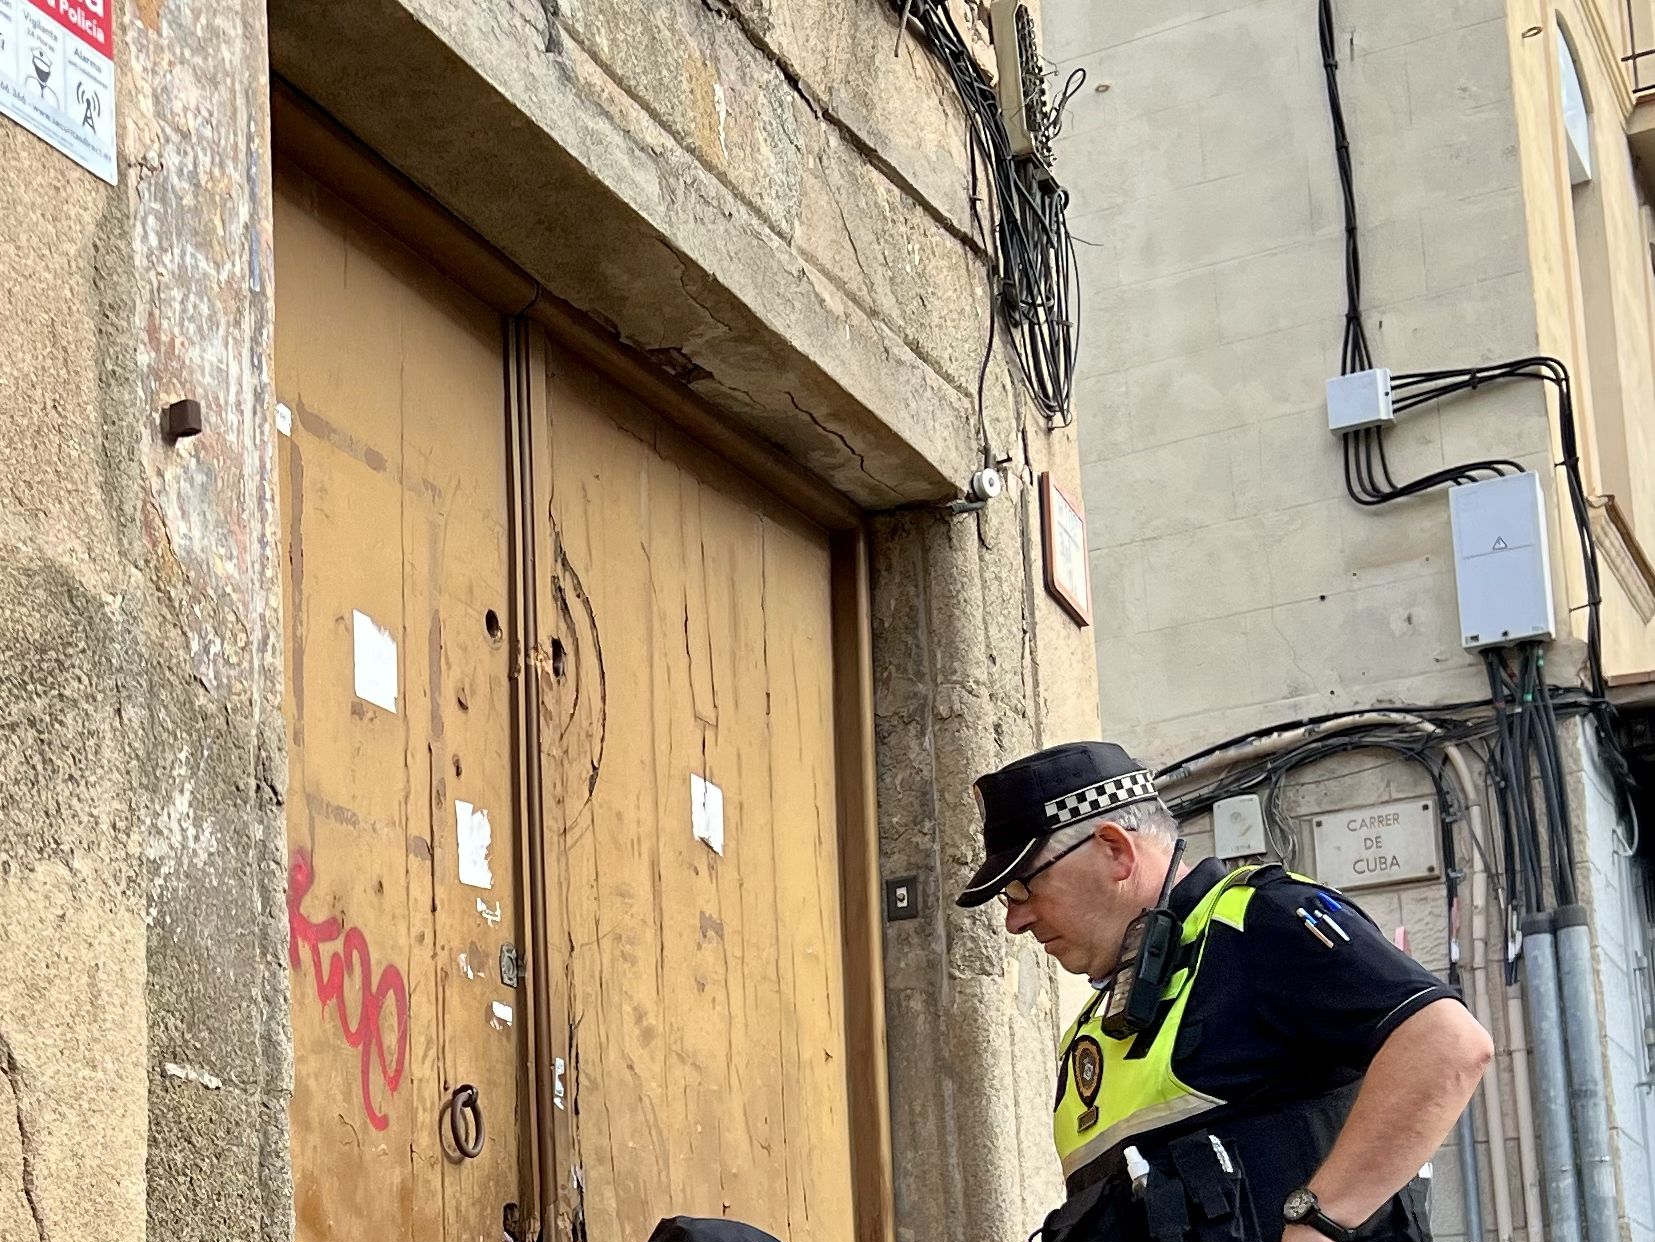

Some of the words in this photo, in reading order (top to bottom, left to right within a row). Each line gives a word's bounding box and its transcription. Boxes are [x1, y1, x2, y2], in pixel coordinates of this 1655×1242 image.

[1346, 812, 1400, 832] CARRER
[1363, 836, 1383, 850] DE
[1352, 855, 1401, 875] CUBA
